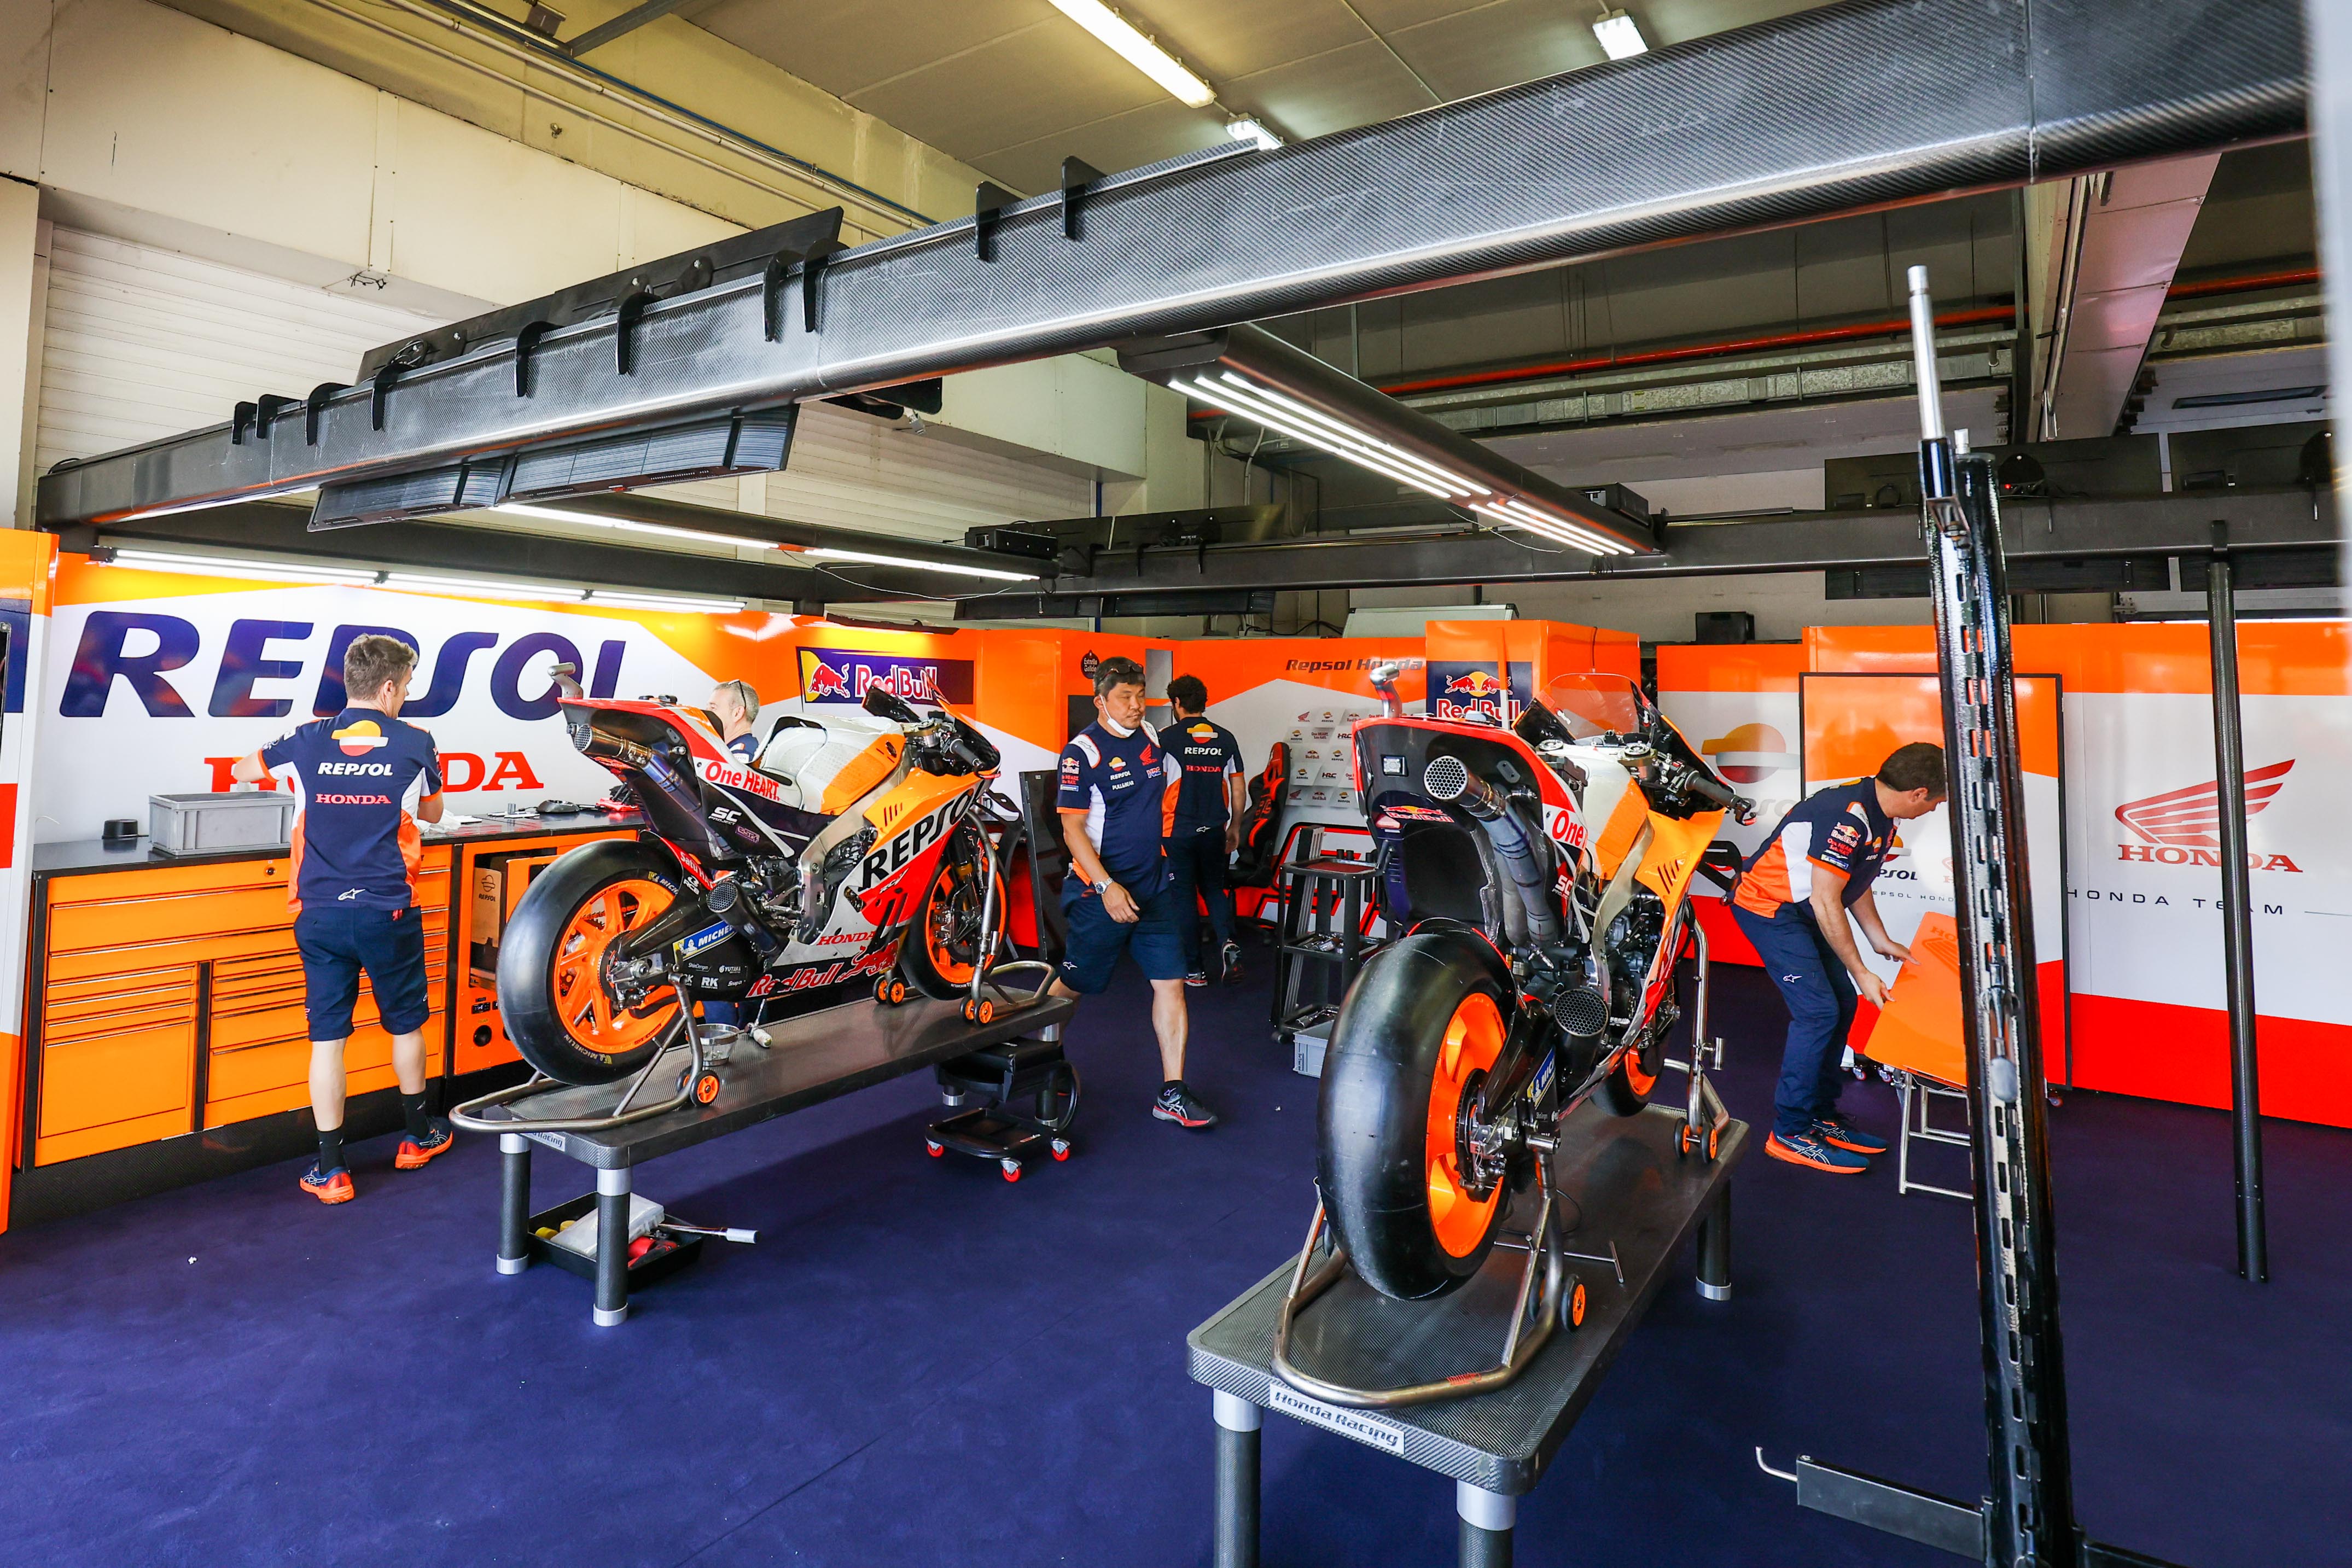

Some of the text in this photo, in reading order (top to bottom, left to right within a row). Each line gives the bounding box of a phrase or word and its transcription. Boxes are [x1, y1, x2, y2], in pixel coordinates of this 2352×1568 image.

[1285, 659, 1352, 673] Repsol
[855, 664, 938, 701] Red Bull
[1436, 698, 1478, 718] Red
[1184, 747, 1222, 755] REPSOL
[318, 762, 393, 776] REPSOL
[705, 761, 742, 786] One
[1110, 771, 1131, 780] REPSOL
[1112, 780, 1134, 790] PULL&BEAR
[316, 794, 392, 804] HONDA
[708, 815, 736, 825] PROJECT
[712, 807, 742, 822] SC
[1385, 812, 1455, 823] Red Bull
[858, 779, 985, 892] REPSOL
[1552, 810, 1583, 847] One
[1831, 829, 1847, 843] Red
[680, 851, 698, 873] Satu
[683, 878, 700, 895] RCB
[2193, 898, 2283, 915] TEM
[817, 931, 875, 946] HONDA
[701, 977, 719, 987] RK
[746, 962, 845, 998] Red Bull
[563, 1034, 598, 1060] MICHELIN
[1275, 1392, 1399, 1447] Honda Racing
